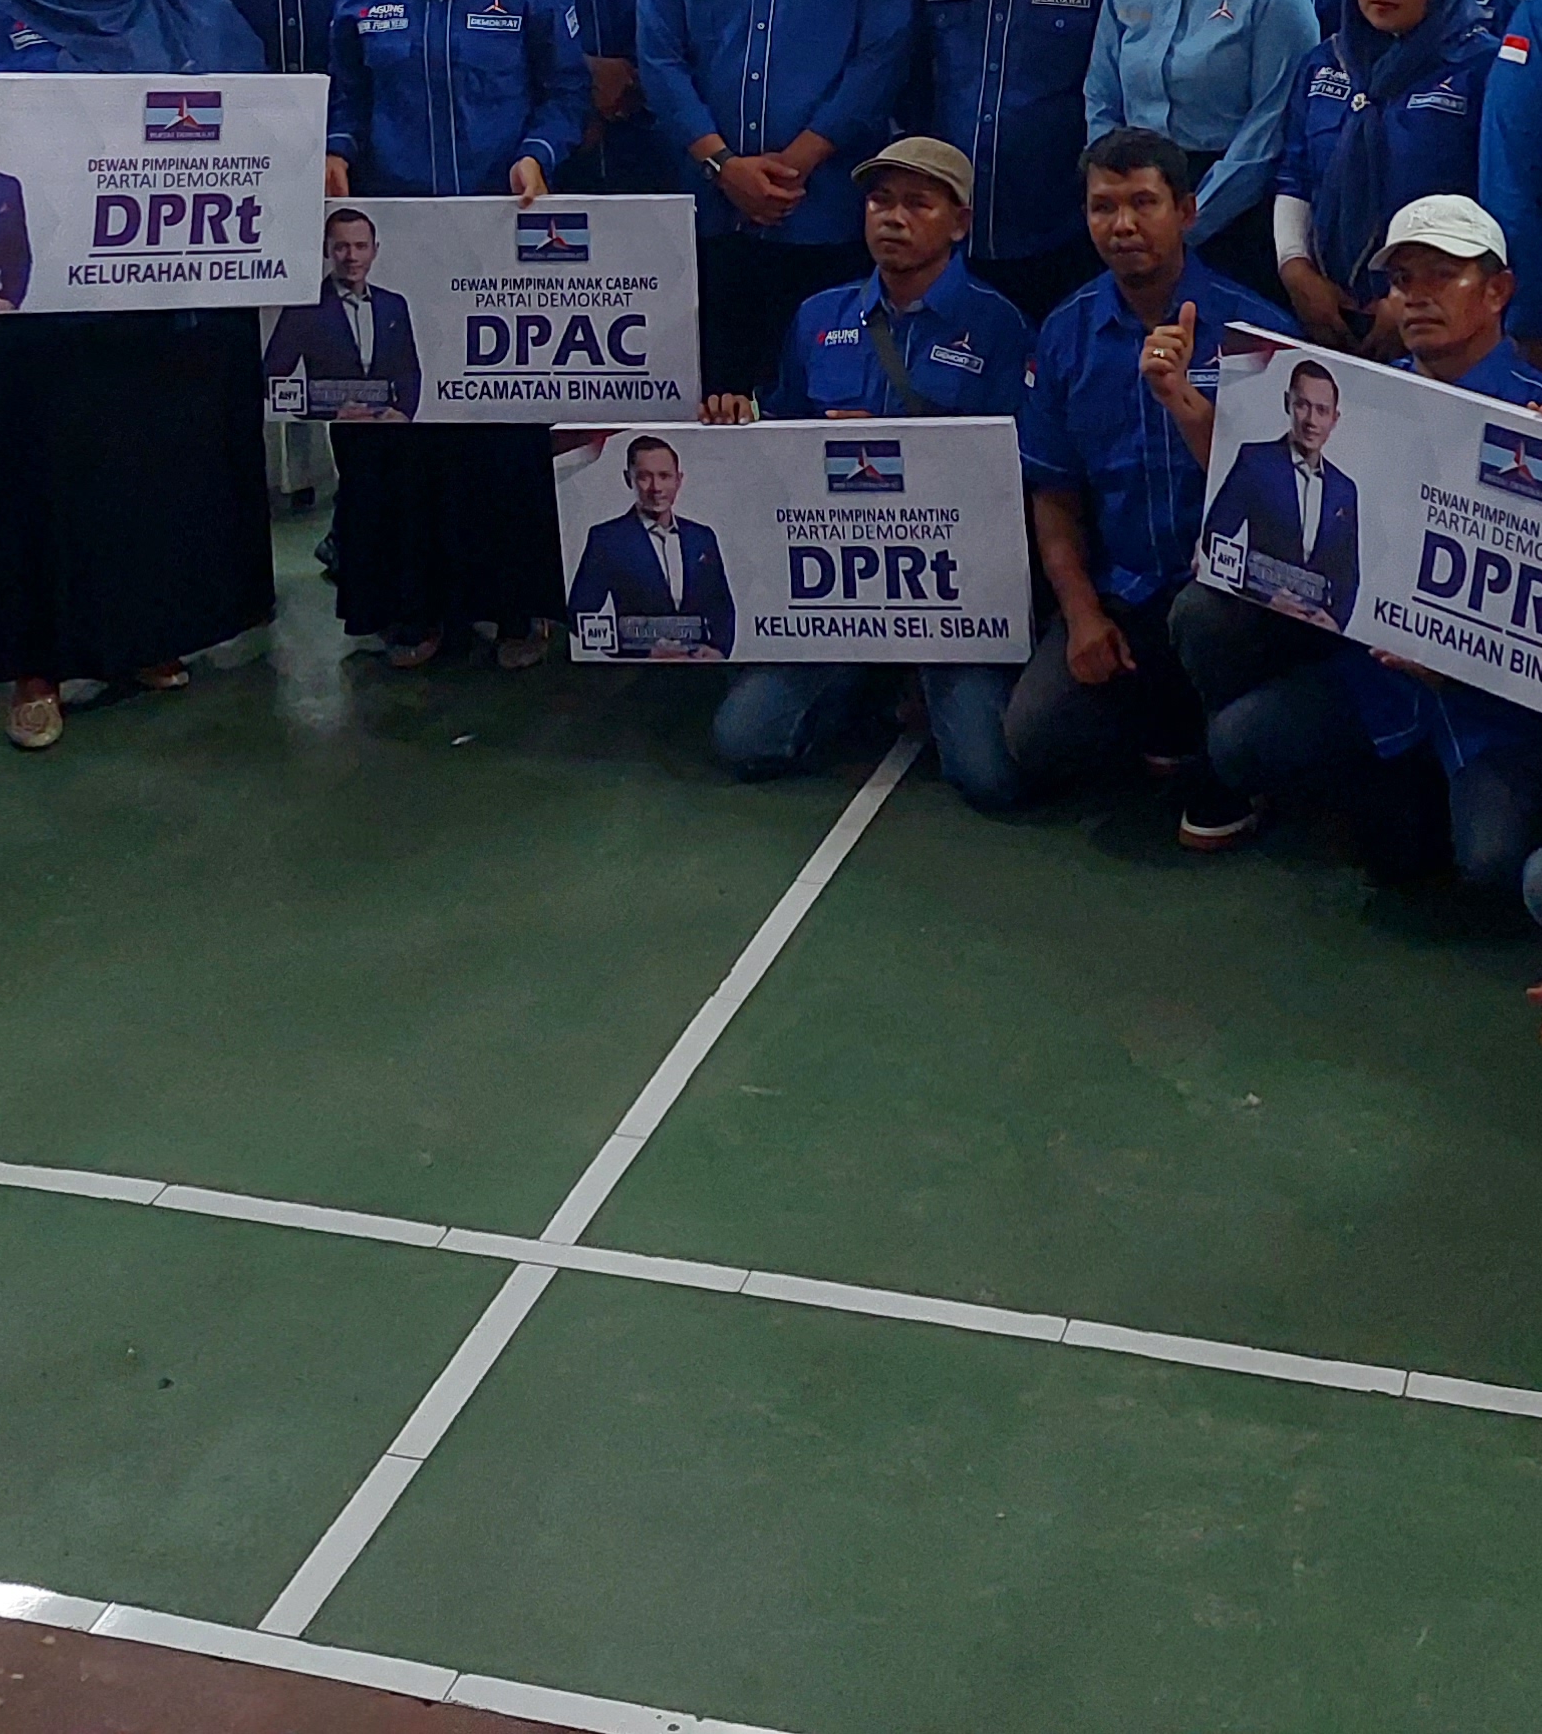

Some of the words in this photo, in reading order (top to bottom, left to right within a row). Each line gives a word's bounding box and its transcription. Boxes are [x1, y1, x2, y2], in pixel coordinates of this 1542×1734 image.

[368, 4, 405, 15] AGUNG
[470, 18, 518, 28] DEMOKRAT
[88, 158, 138, 173] DEWAN
[142, 157, 210, 171] PIMPINAN
[212, 156, 271, 170] RANTING
[96, 172, 157, 189] PARTAI
[163, 171, 264, 188] DEMOKRAT
[92, 193, 262, 248] DPRt
[67, 261, 202, 286] KELURAHAN
[209, 259, 288, 282] DELIMA
[451, 278, 498, 292] DEWAN
[501, 277, 564, 291] PIMPINAN
[567, 277, 603, 291] ANAK
[605, 276, 658, 290] CABANG
[475, 293, 532, 308] PARTAI
[537, 292, 633, 308] DEMOKRAT
[466, 314, 647, 366] DPAC
[436, 380, 561, 401] KECAMATAN
[568, 380, 681, 401] BINAWIDYA
[776, 509, 825, 523] DEWAN
[828, 508, 896, 523] PIMPINAN
[900, 508, 959, 522] RANTING
[1420, 483, 1469, 515] DEWAN
[1472, 501, 1541, 539] PIMPINAN
[787, 525, 846, 540] PARTAI
[852, 524, 954, 540] DEMOKRAT
[1426, 505, 1486, 541] PARTAI
[1217, 552, 1237, 568] AHY
[788, 545, 959, 601] DPRt
[754, 616, 887, 637] KELURAHAN
[893, 616, 934, 639] SEI.
[940, 617, 1010, 639] SIBAM
[1374, 597, 1504, 667] KELURAHAN
